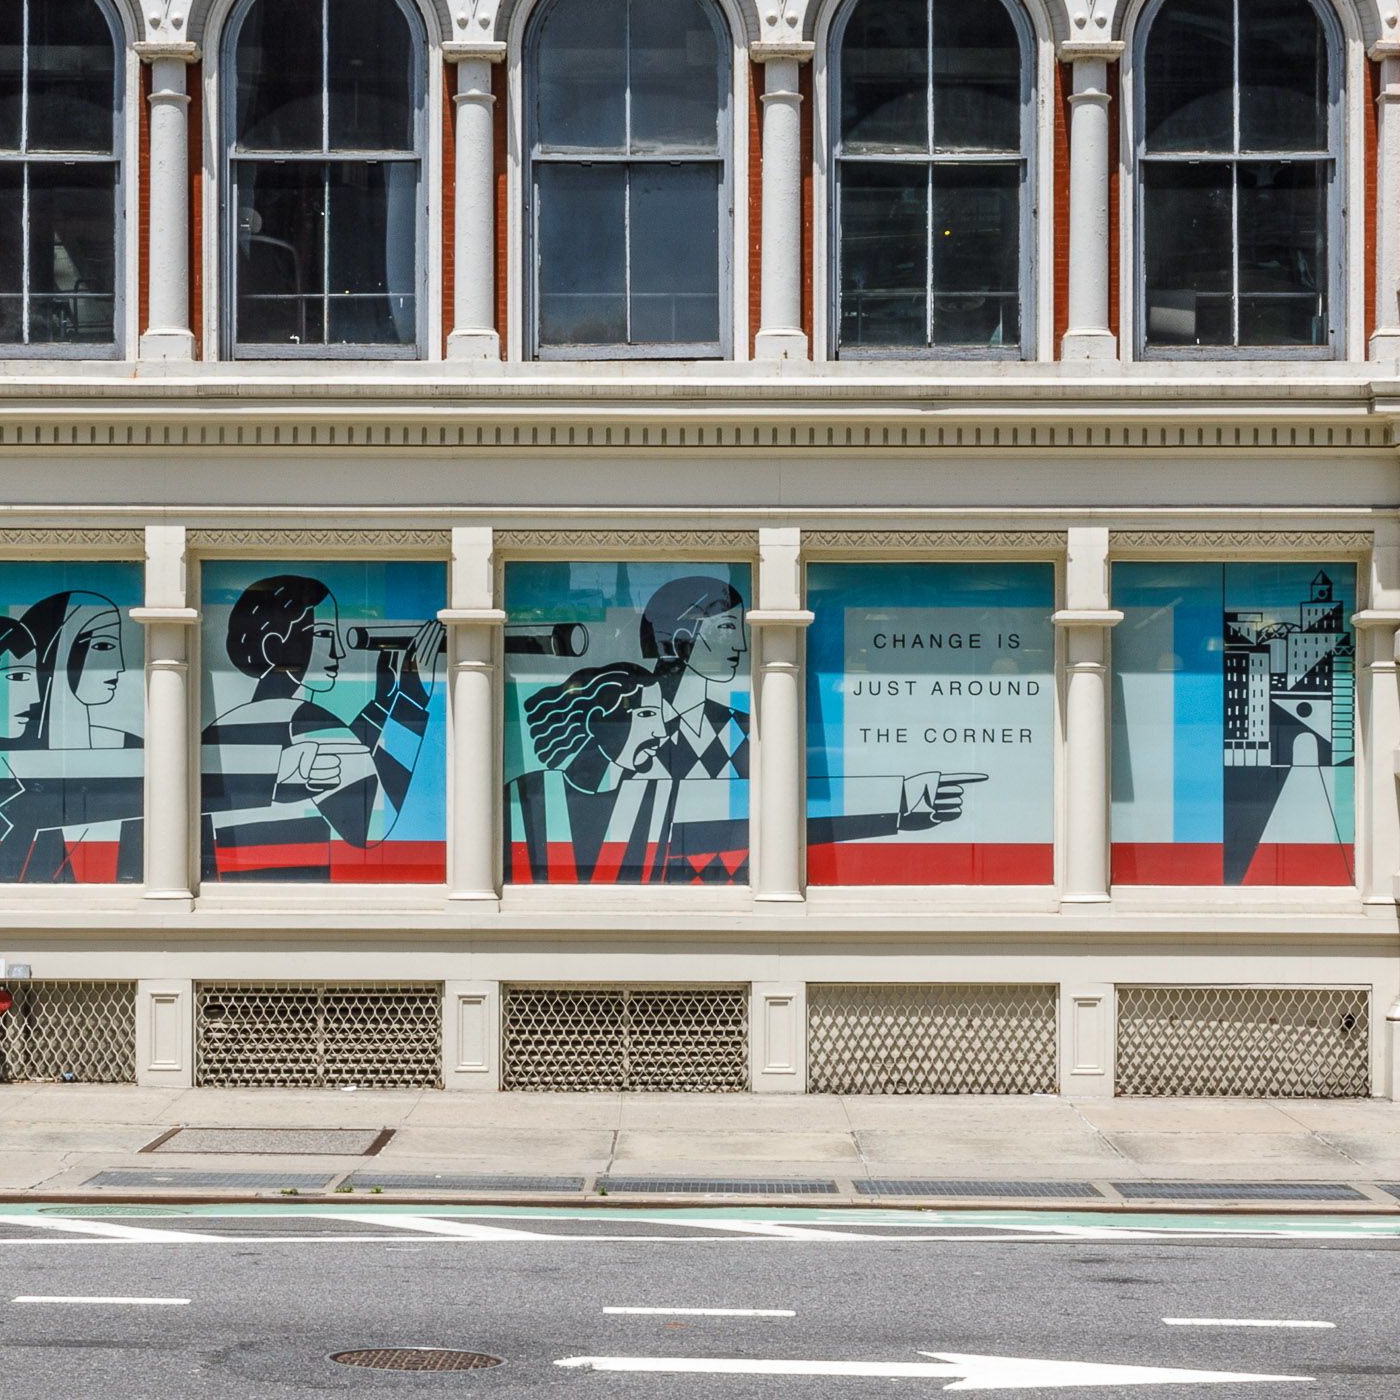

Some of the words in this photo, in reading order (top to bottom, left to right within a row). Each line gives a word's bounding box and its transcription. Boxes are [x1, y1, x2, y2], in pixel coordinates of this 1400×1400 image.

[873, 633, 982, 649] CHANGE
[997, 633, 1021, 649] IS
[853, 680, 917, 696] JUST
[930, 680, 1040, 696] AROUND
[859, 728, 908, 744] THE
[923, 727, 1032, 744] CORNER
